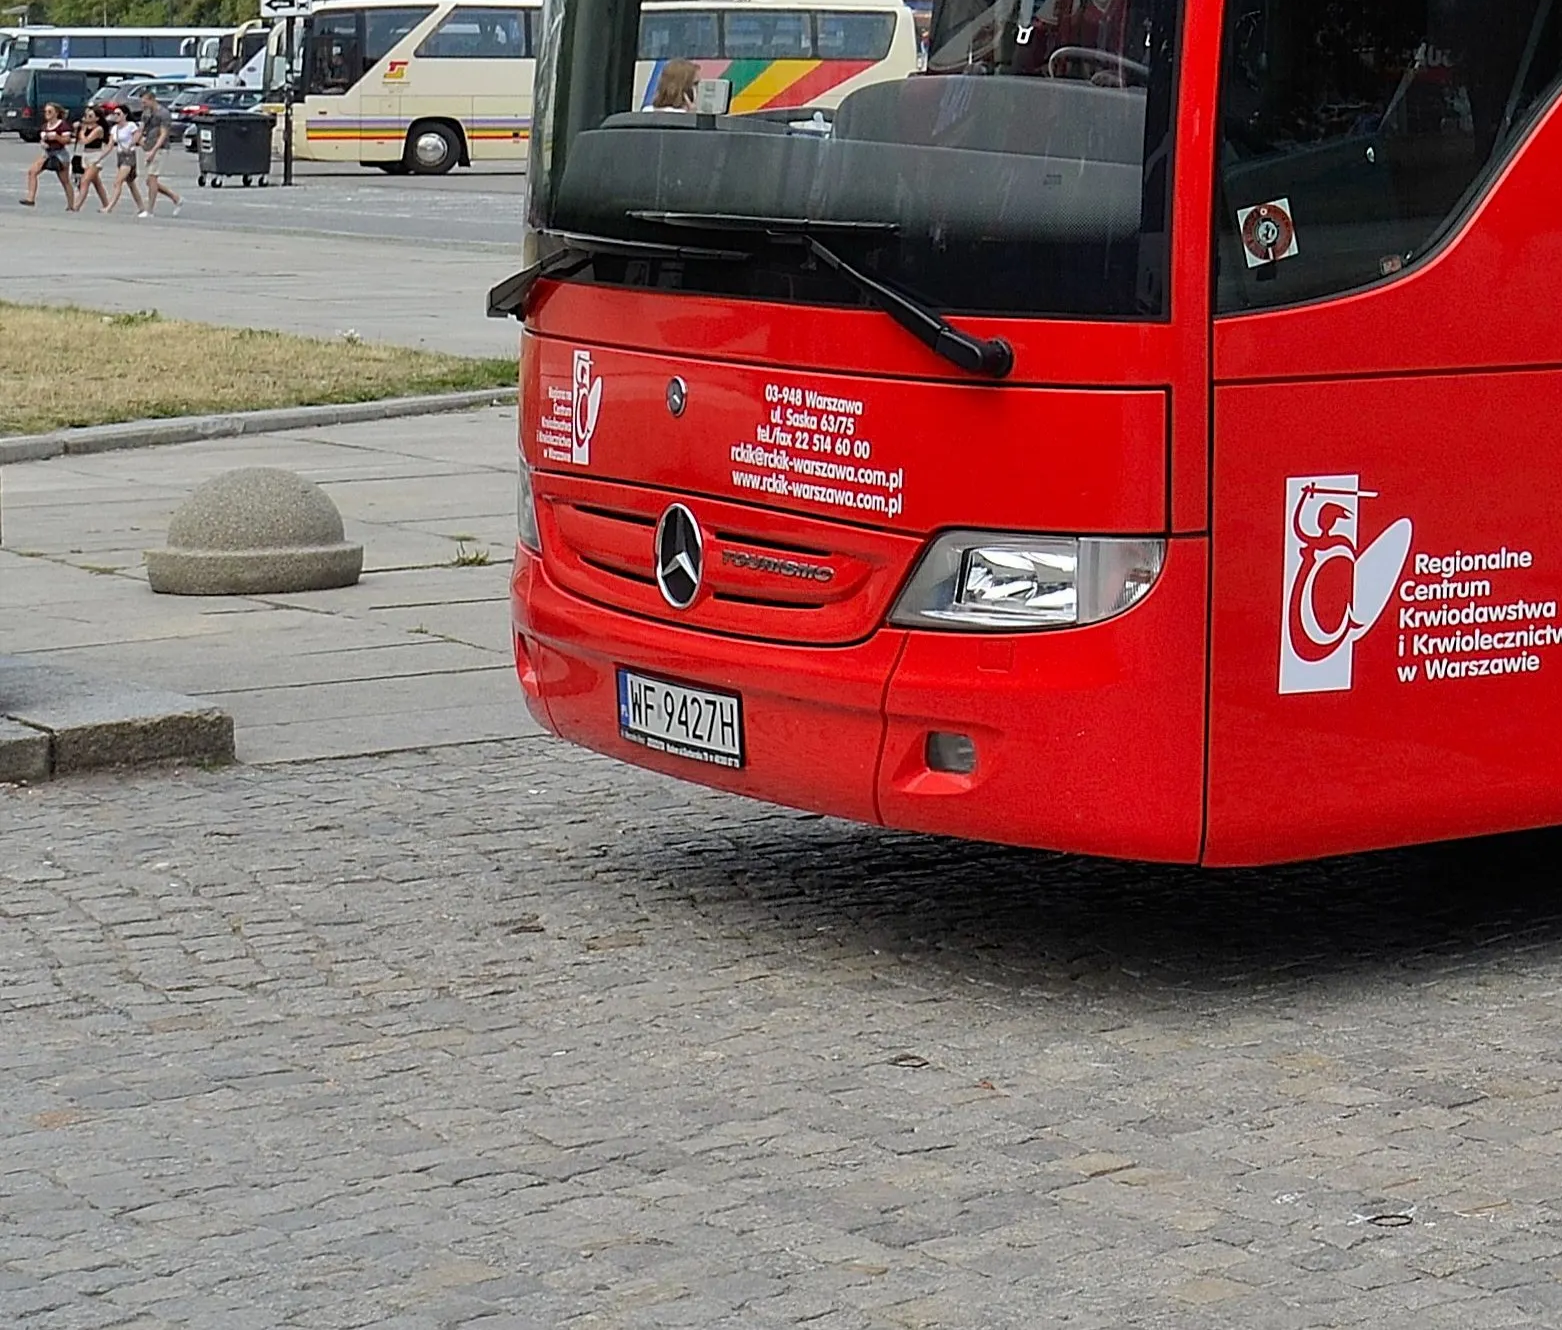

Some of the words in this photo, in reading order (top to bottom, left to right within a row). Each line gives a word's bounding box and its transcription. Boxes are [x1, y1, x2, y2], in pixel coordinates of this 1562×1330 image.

[765, 383, 802, 407] 03-948
[805, 390, 863, 415] Warszawa
[770, 406, 783, 425] ul.
[786, 408, 817, 431] Saska
[820, 413, 855, 436] 63/75
[757, 425, 793, 447] tel./fax
[795, 431, 810, 450] 22
[812, 434, 832, 454] 514
[835, 438, 851, 457] 60
[854, 440, 871, 460] 00
[731, 442, 903, 493] rckik@rckik-warszawa.com.pl
[732, 470, 902, 519] www.rckik-warszawa.com.pl
[722, 549, 835, 582] TOURISMO
[1415, 546, 1533, 577] Regionalne
[1400, 579, 1490, 602] Centrum
[1399, 598, 1557, 629] Krwiodawstwa
[1398, 635, 1405, 657] i
[1397, 665, 1418, 682] w
[1425, 651, 1540, 680] Warszawie
[630, 680, 656, 727] WF
[664, 690, 736, 748] 9427H
